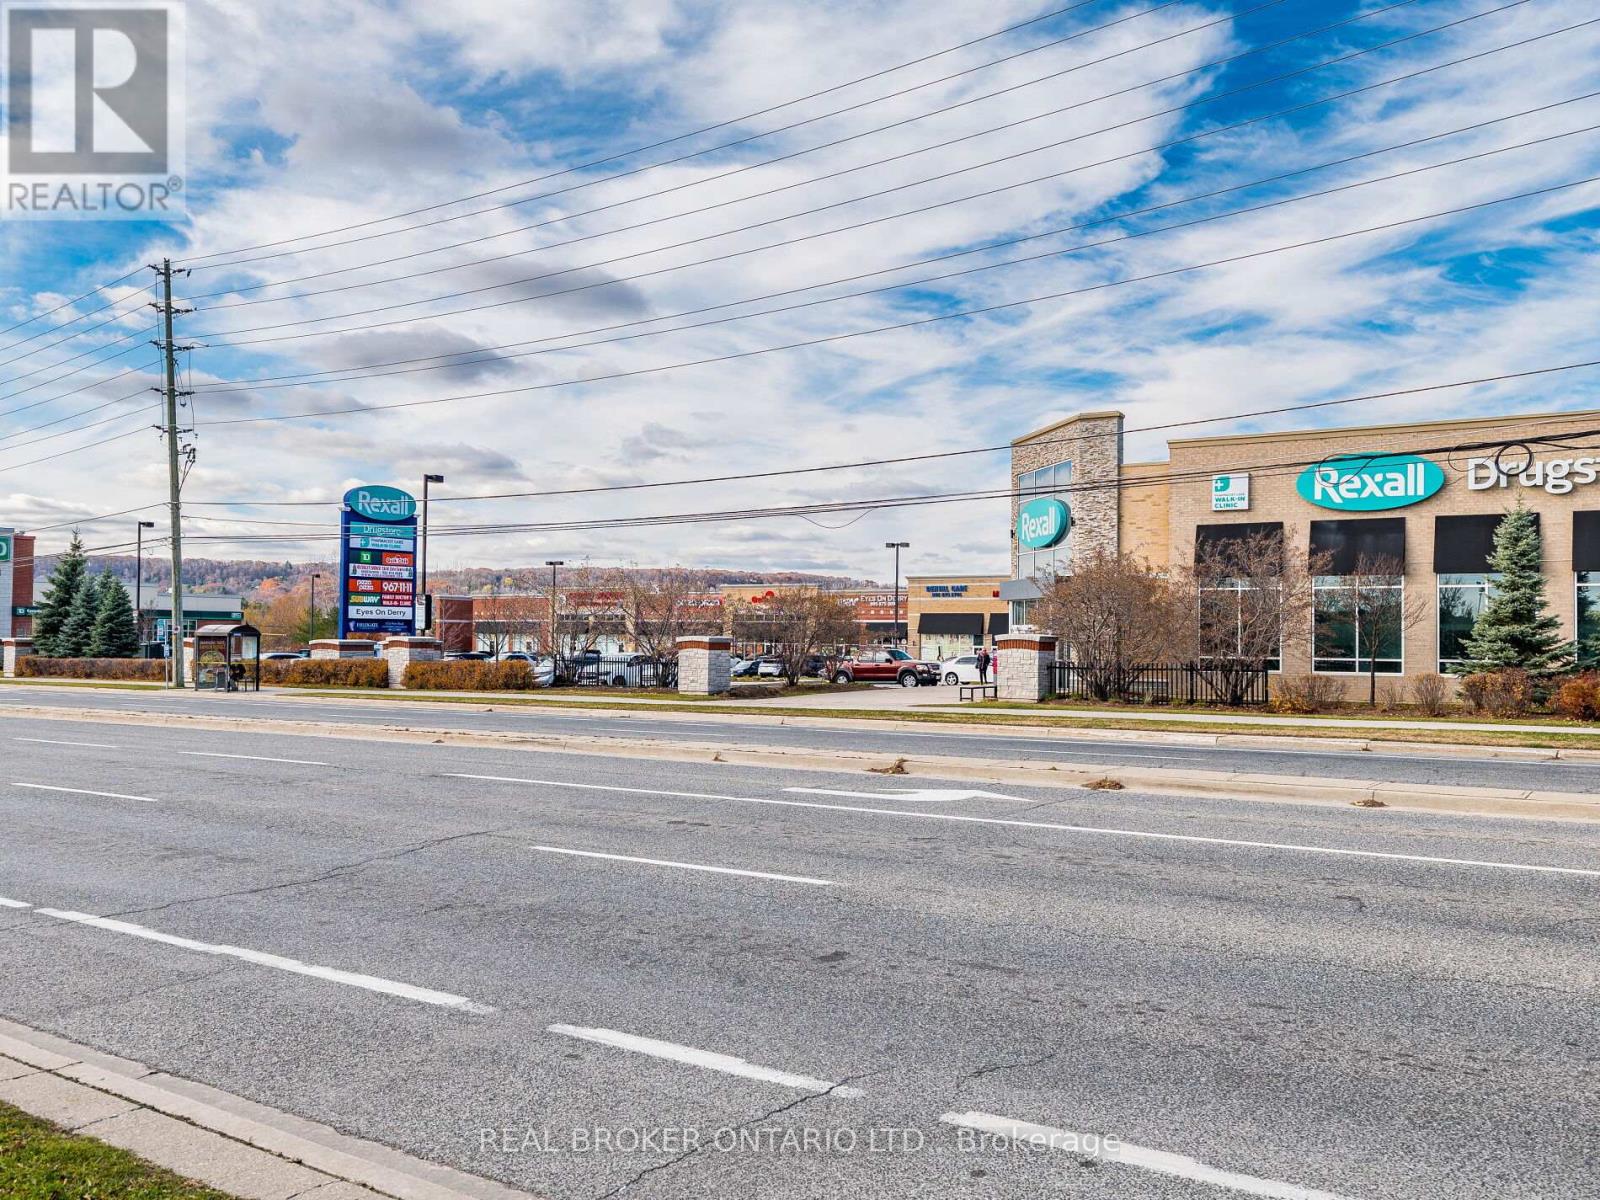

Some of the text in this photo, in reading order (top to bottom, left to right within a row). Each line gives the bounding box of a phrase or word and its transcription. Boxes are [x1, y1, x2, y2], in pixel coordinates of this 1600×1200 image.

[1314, 463, 1425, 504] Rexall
[1467, 456, 1600, 494] Drugs
[358, 490, 409, 515] Rexall
[1021, 506, 1056, 542] Rexall
[349, 595, 380, 604] SUBWAY
[356, 608, 407, 617] Eyes On Derry
